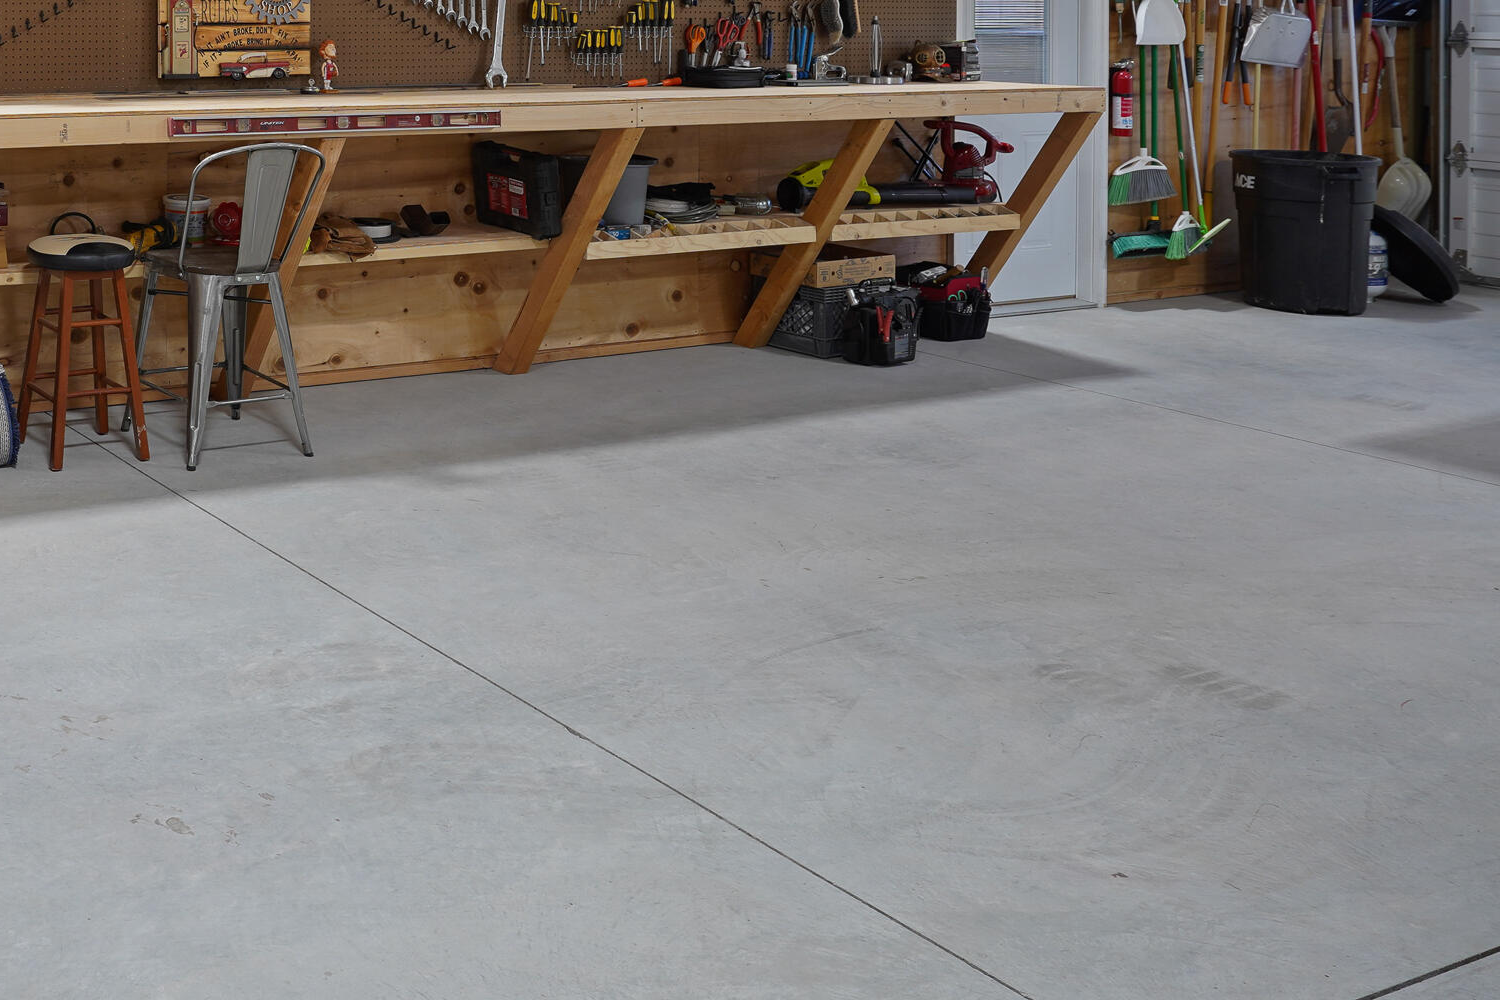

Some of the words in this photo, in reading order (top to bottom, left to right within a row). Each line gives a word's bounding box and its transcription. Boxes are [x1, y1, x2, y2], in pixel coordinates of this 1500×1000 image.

[201, 0, 238, 23] RULES
[258, 0, 293, 15] SHOP
[206, 42, 213, 50] IT
[214, 31, 231, 44] AIN'T
[255, 26, 274, 34] DON'T
[277, 29, 288, 39] FIX
[202, 59, 210, 69] IF
[246, 38, 263, 46] BRING
[1234, 172, 1256, 189] ACE
